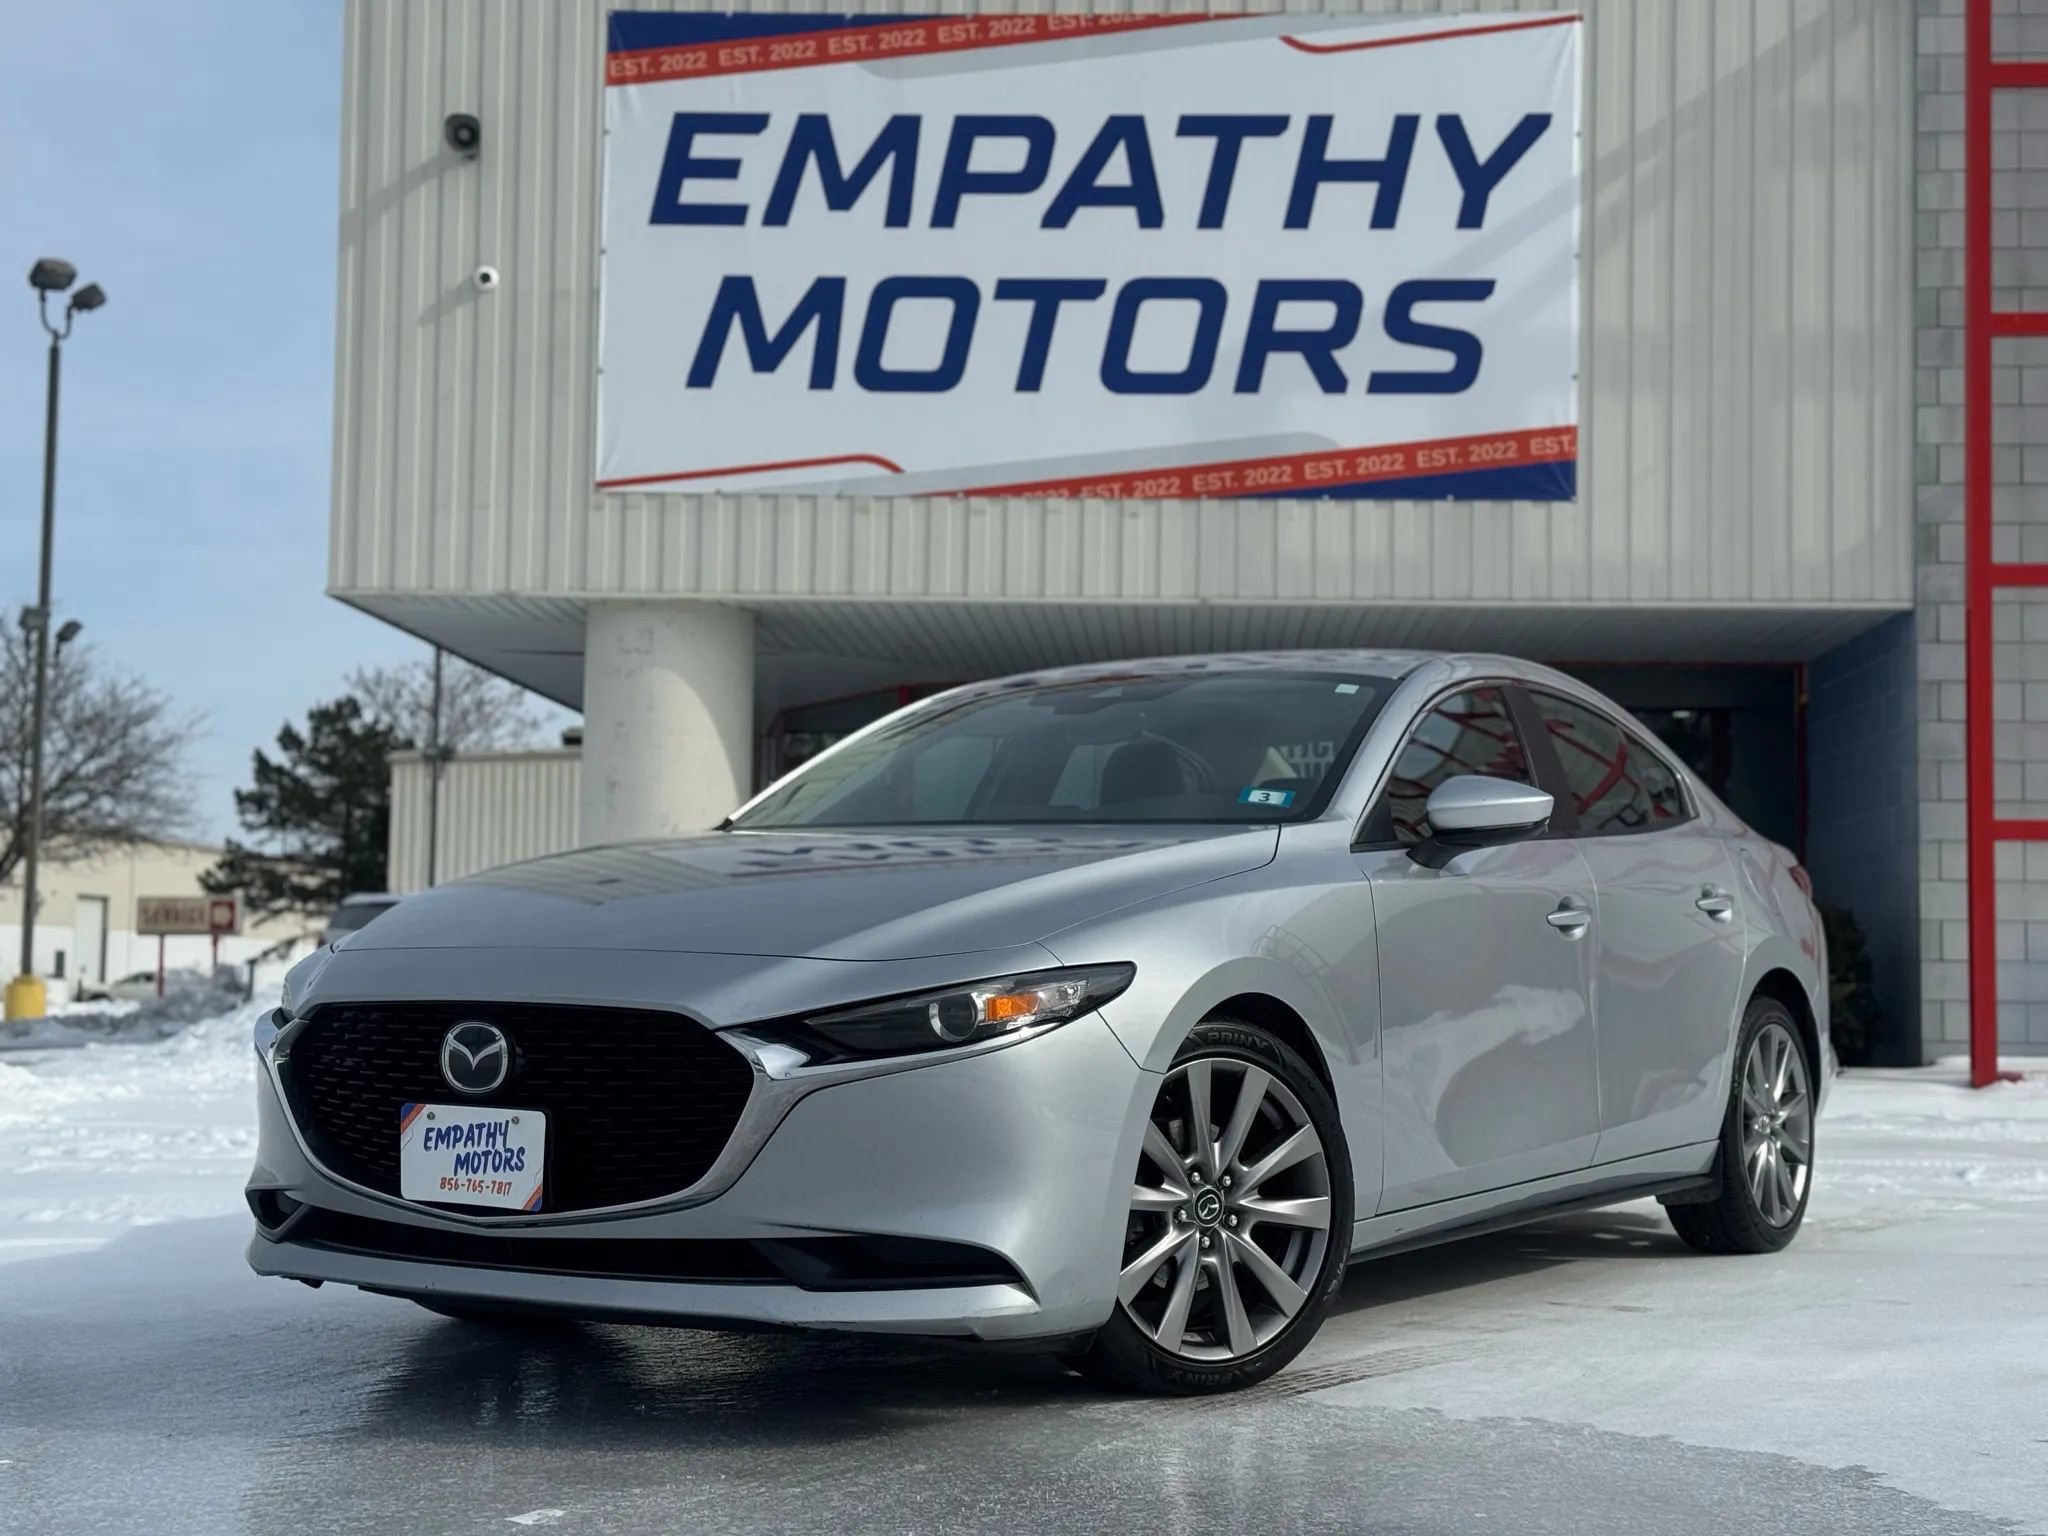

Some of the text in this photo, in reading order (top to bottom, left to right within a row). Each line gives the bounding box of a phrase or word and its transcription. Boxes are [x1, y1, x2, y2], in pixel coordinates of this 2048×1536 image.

[609, 57, 655, 78] EST.
[660, 51, 708, 73] 2022
[718, 46, 764, 66] EST.
[769, 40, 818, 61] 2022
[828, 34, 874, 55] EST.
[878, 28, 926, 50] 2022
[937, 22, 983, 44] EST.
[988, 16, 1036, 39] 2022
[650, 113, 1551, 229] EMPATHY
[687, 276, 1495, 394] MOTORS
[1132, 477, 1180, 498] 2022
[1192, 471, 1239, 493] EST.
[1244, 465, 1293, 487] 2022
[1304, 459, 1350, 480] EST.
[1356, 453, 1405, 475] 2022
[1417, 446, 1462, 468] EST.
[1469, 440, 1518, 463] 2022
[1529, 434, 1576, 456] EST.
[1259, 792, 1271, 802] 3
[423, 1119, 510, 1152] EMPATHY
[453, 1146, 526, 1177] MOTORS
[440, 1177, 512, 1197] 856-765-7817
